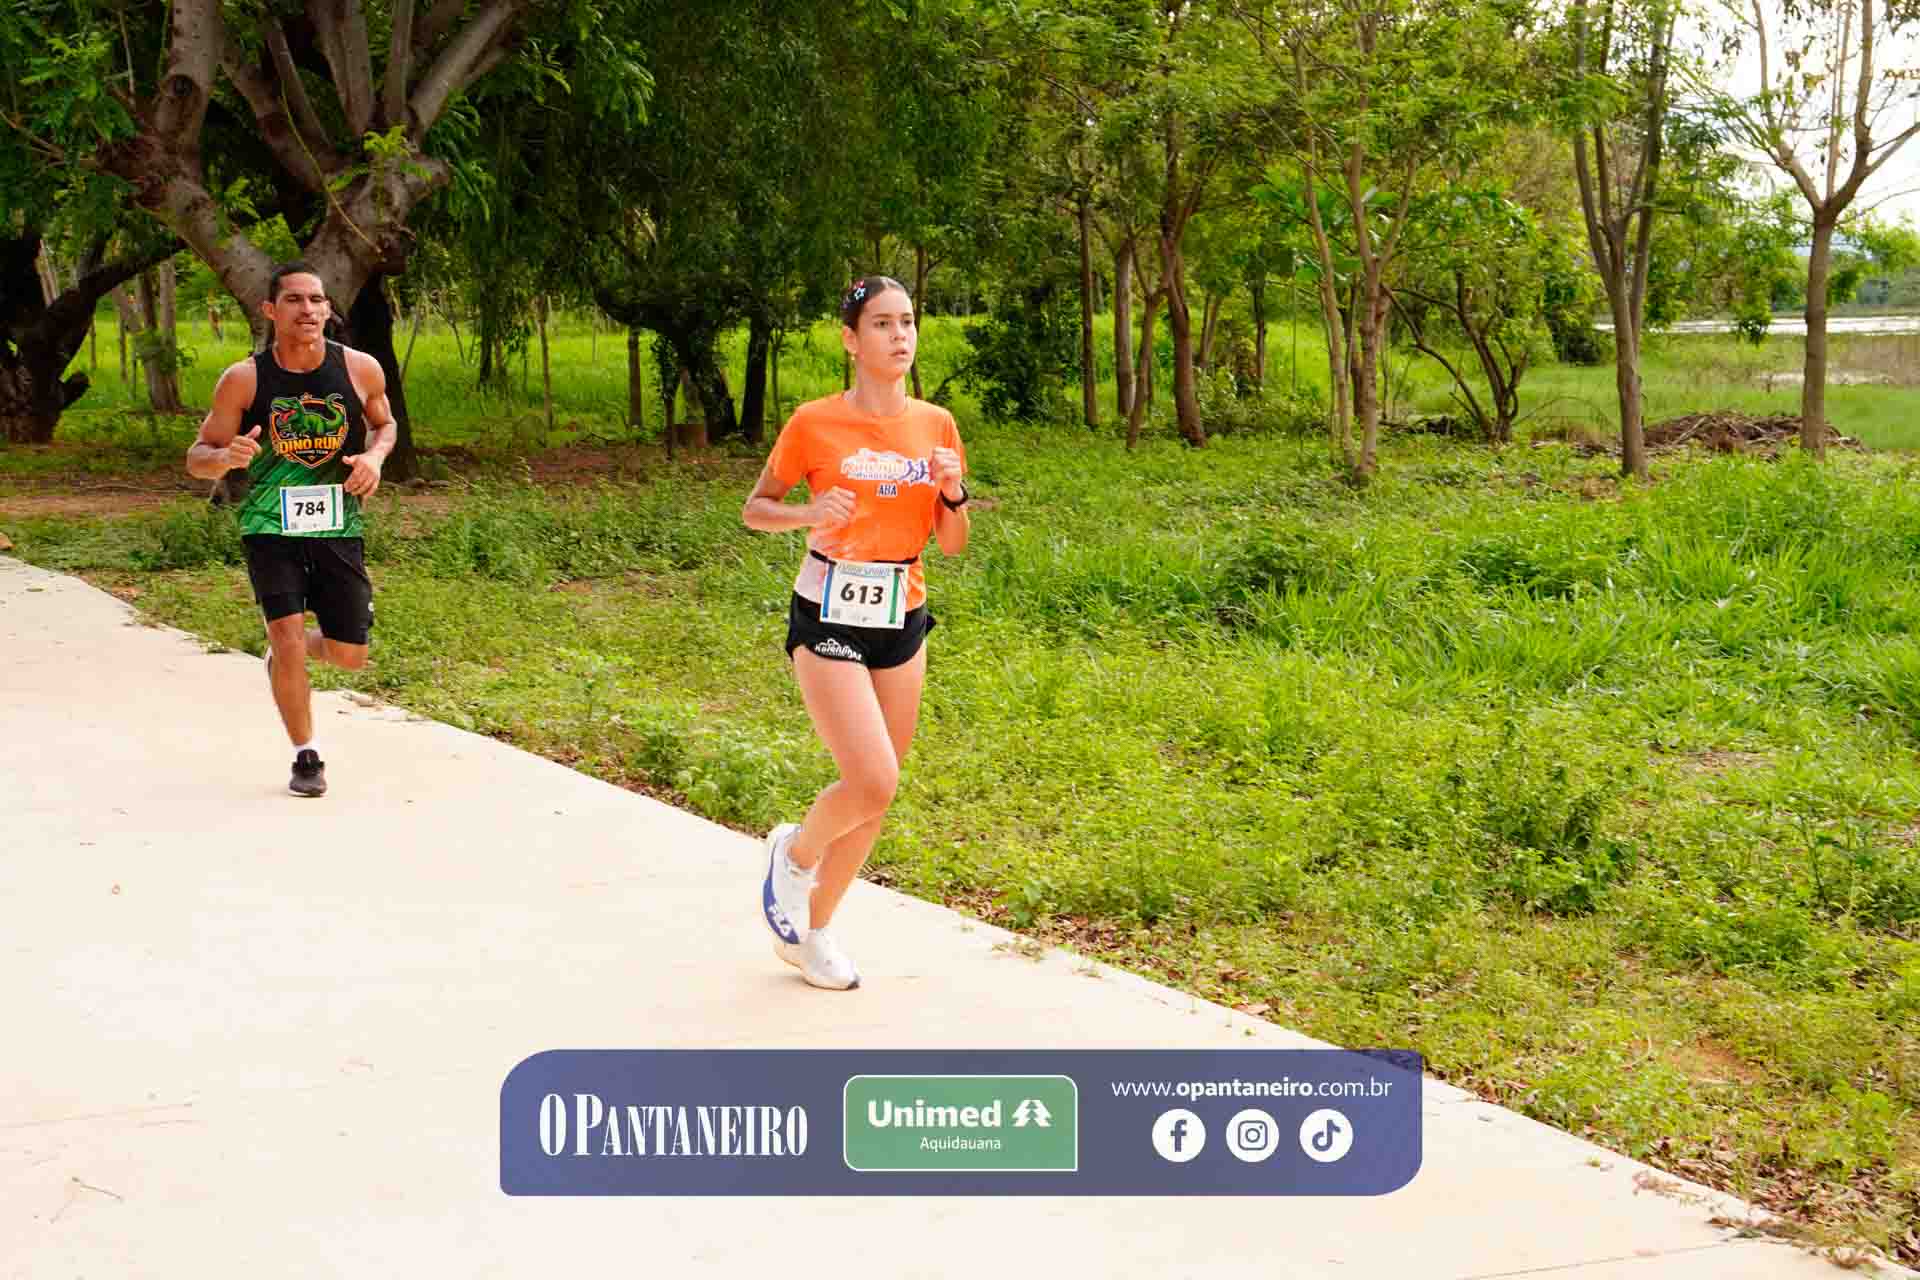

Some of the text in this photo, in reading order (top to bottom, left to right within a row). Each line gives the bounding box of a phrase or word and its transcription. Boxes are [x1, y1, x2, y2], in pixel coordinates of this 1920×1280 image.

[279, 436, 342, 455] DINO RUN
[294, 501, 326, 517] 784
[840, 582, 884, 605] 613
